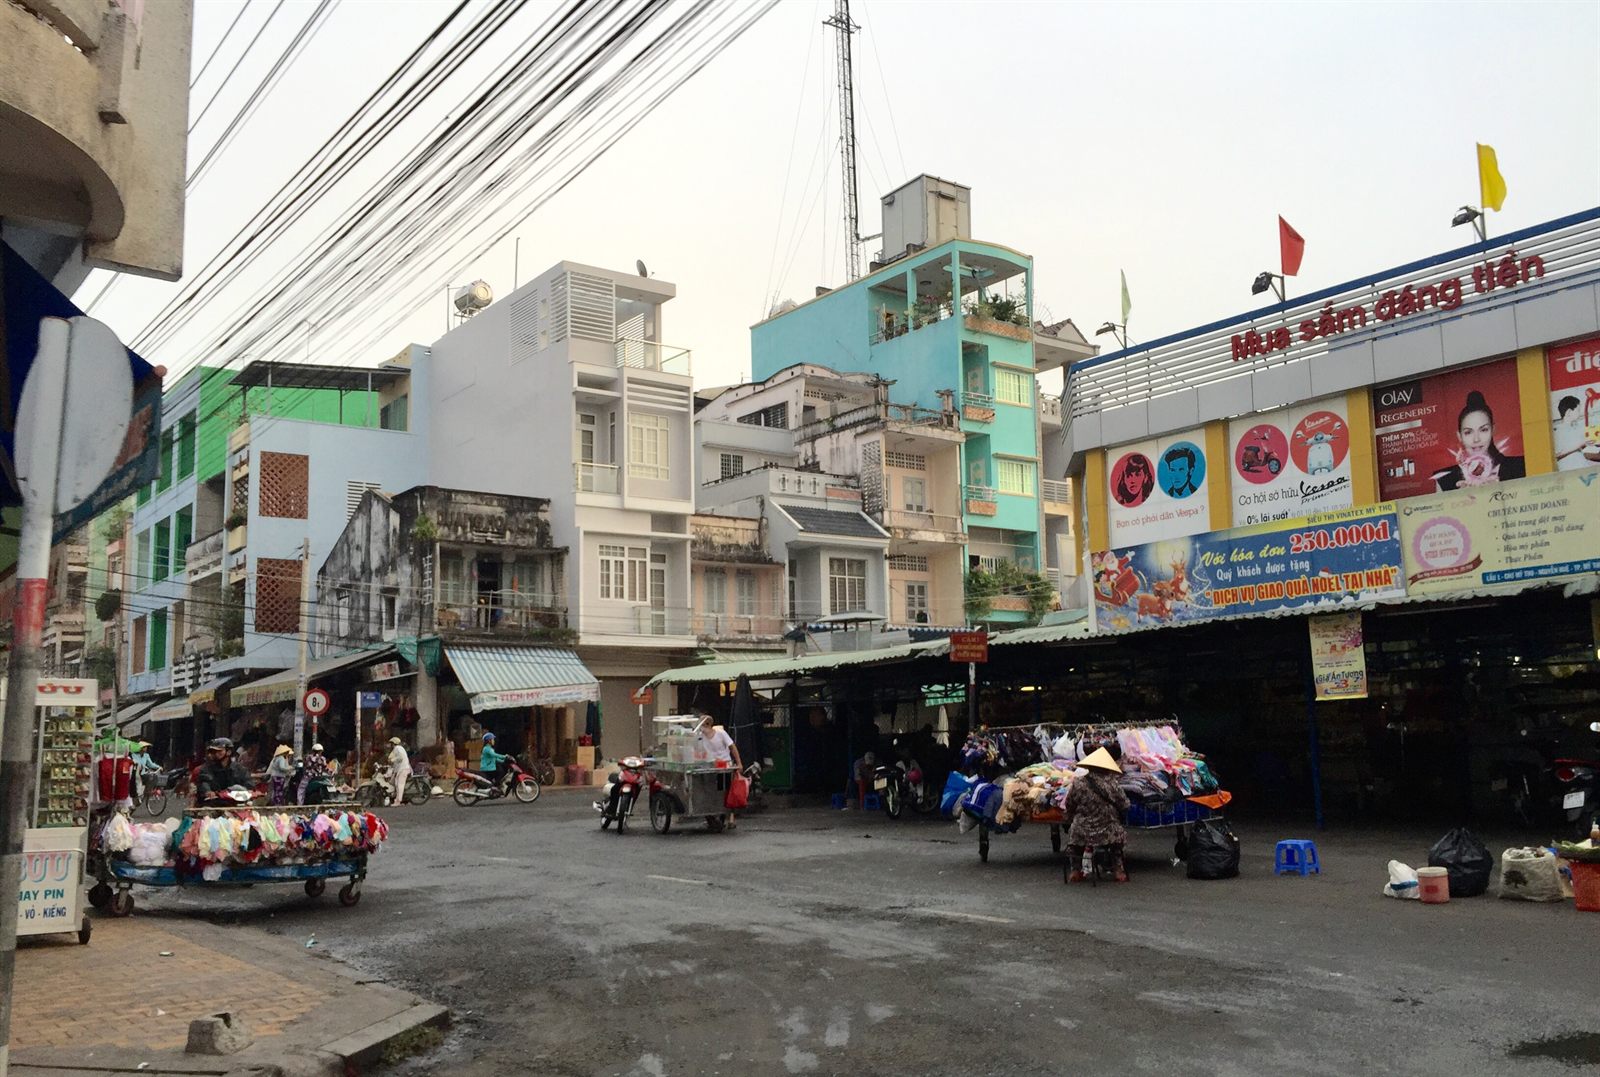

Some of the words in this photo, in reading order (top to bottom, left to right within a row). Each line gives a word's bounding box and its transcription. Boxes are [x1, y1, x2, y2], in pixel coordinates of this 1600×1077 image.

[1231, 326, 1291, 362] Mua
[1298, 300, 1367, 341] sắm
[1374, 277, 1463, 321] đáng
[1472, 249, 1546, 294] tiền
[1381, 386, 1413, 406] OLAY
[1380, 404, 1438, 424] REGENERIST
[1246, 514, 1259, 525] 0%
[1336, 508, 1364, 520] VINATEX
[1216, 568, 1233, 582] Quý
[1236, 564, 1261, 578] khách
[1240, 584, 1256, 606] VỤ
[1257, 581, 1284, 601] GIAO
[1286, 574, 1310, 600] QUÀ
[1342, 572, 1363, 594] TẠI
[44, 889, 65, 900] PIN
